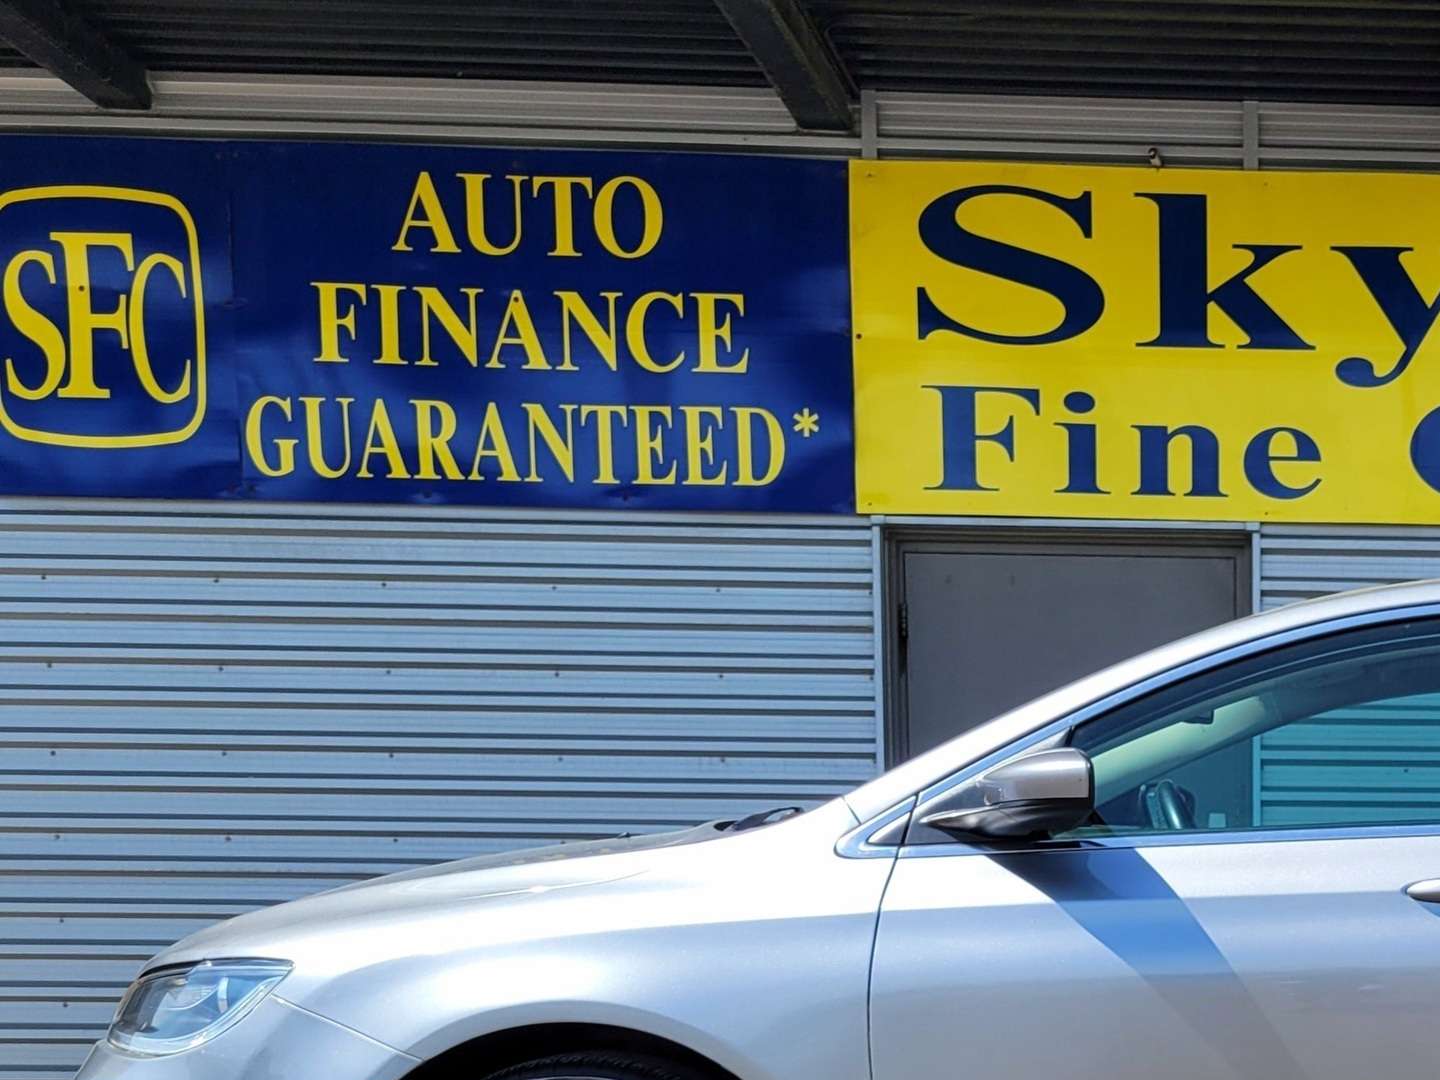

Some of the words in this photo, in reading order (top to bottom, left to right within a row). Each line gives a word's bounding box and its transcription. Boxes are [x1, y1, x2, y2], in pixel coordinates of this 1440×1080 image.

[393, 170, 664, 259] AUTO
[3, 231, 192, 403] SFC
[310, 280, 750, 374] FINANCE
[922, 384, 1323, 500] Fine
